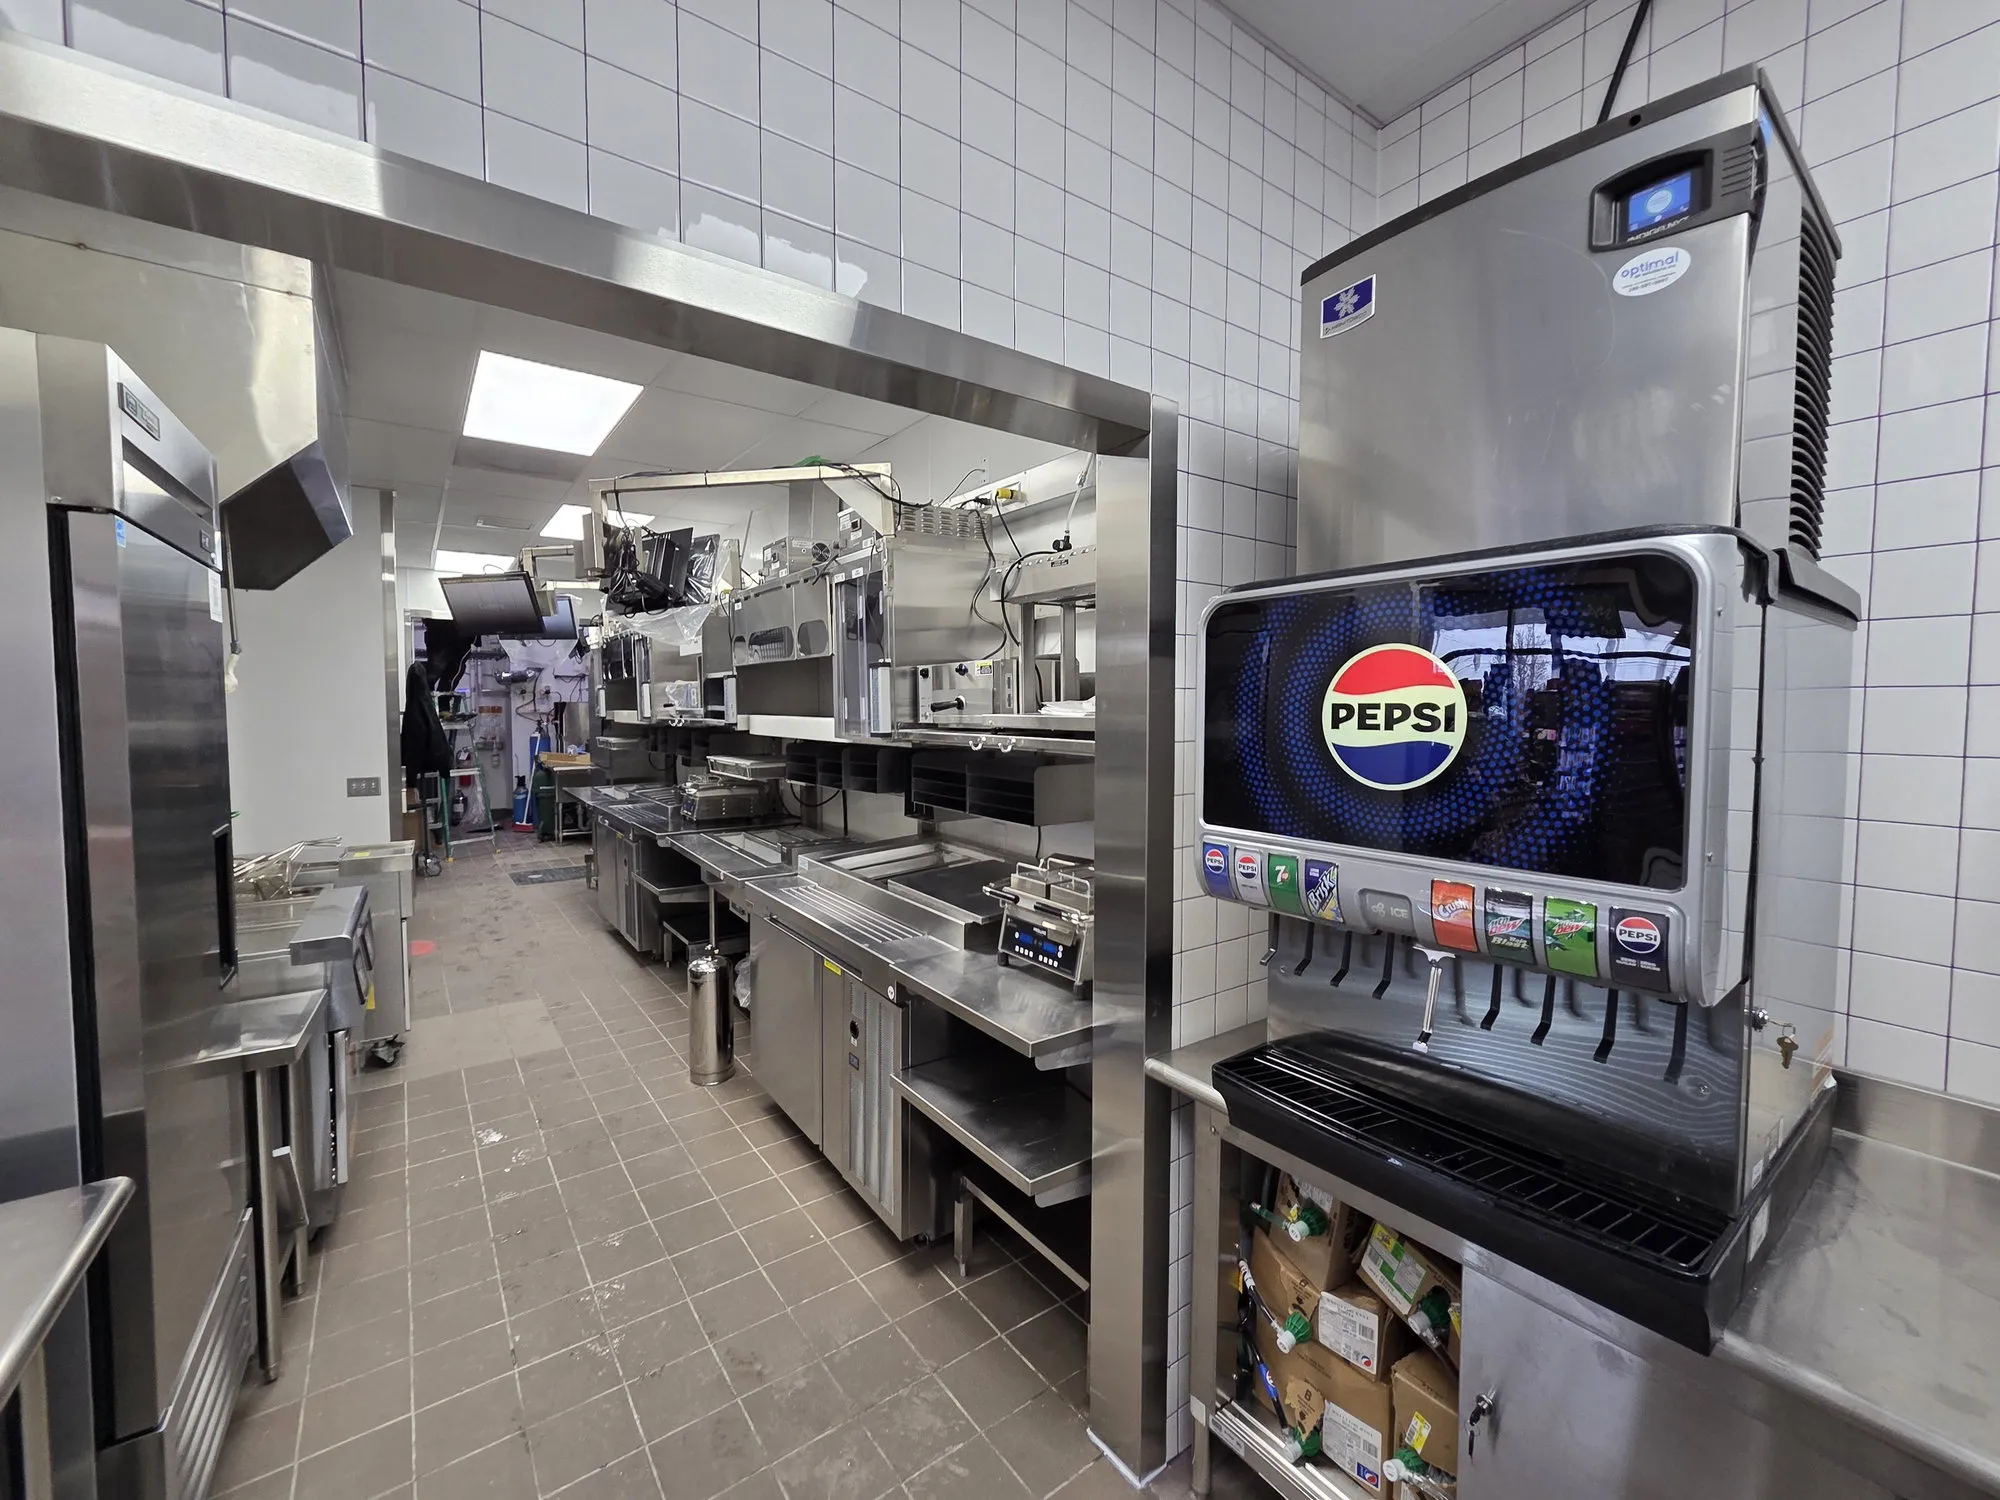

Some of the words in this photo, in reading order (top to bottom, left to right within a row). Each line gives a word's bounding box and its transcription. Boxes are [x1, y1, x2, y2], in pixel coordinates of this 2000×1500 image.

[1621, 251, 1679, 278] optimal
[1331, 702, 1456, 733] PEPSI
[1207, 857, 1224, 866] PEPSI
[1238, 863, 1257, 872] PEPSI
[1390, 906, 1409, 919] ICE
[1438, 898, 1470, 918] Crush
[1618, 928, 1658, 942] PEPSI
